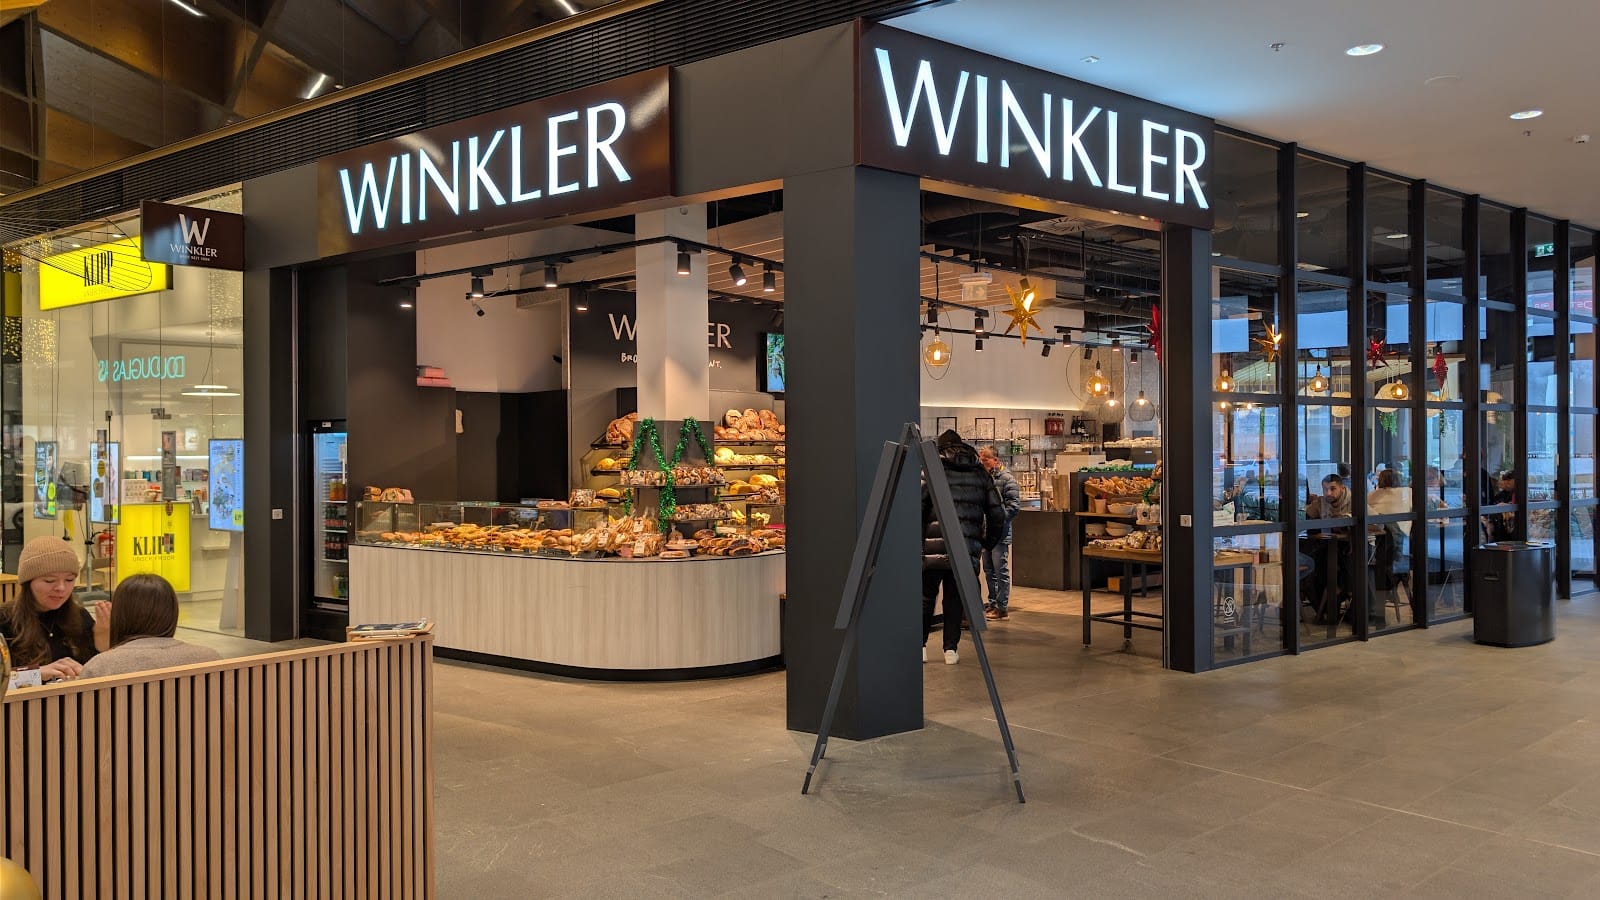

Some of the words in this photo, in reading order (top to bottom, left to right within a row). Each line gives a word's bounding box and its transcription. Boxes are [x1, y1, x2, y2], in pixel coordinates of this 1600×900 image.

[339, 101, 632, 235] WINKLER
[875, 47, 1209, 210] WINKLER
[169, 243, 218, 258] WINKLER
[178, 213, 211, 246] W
